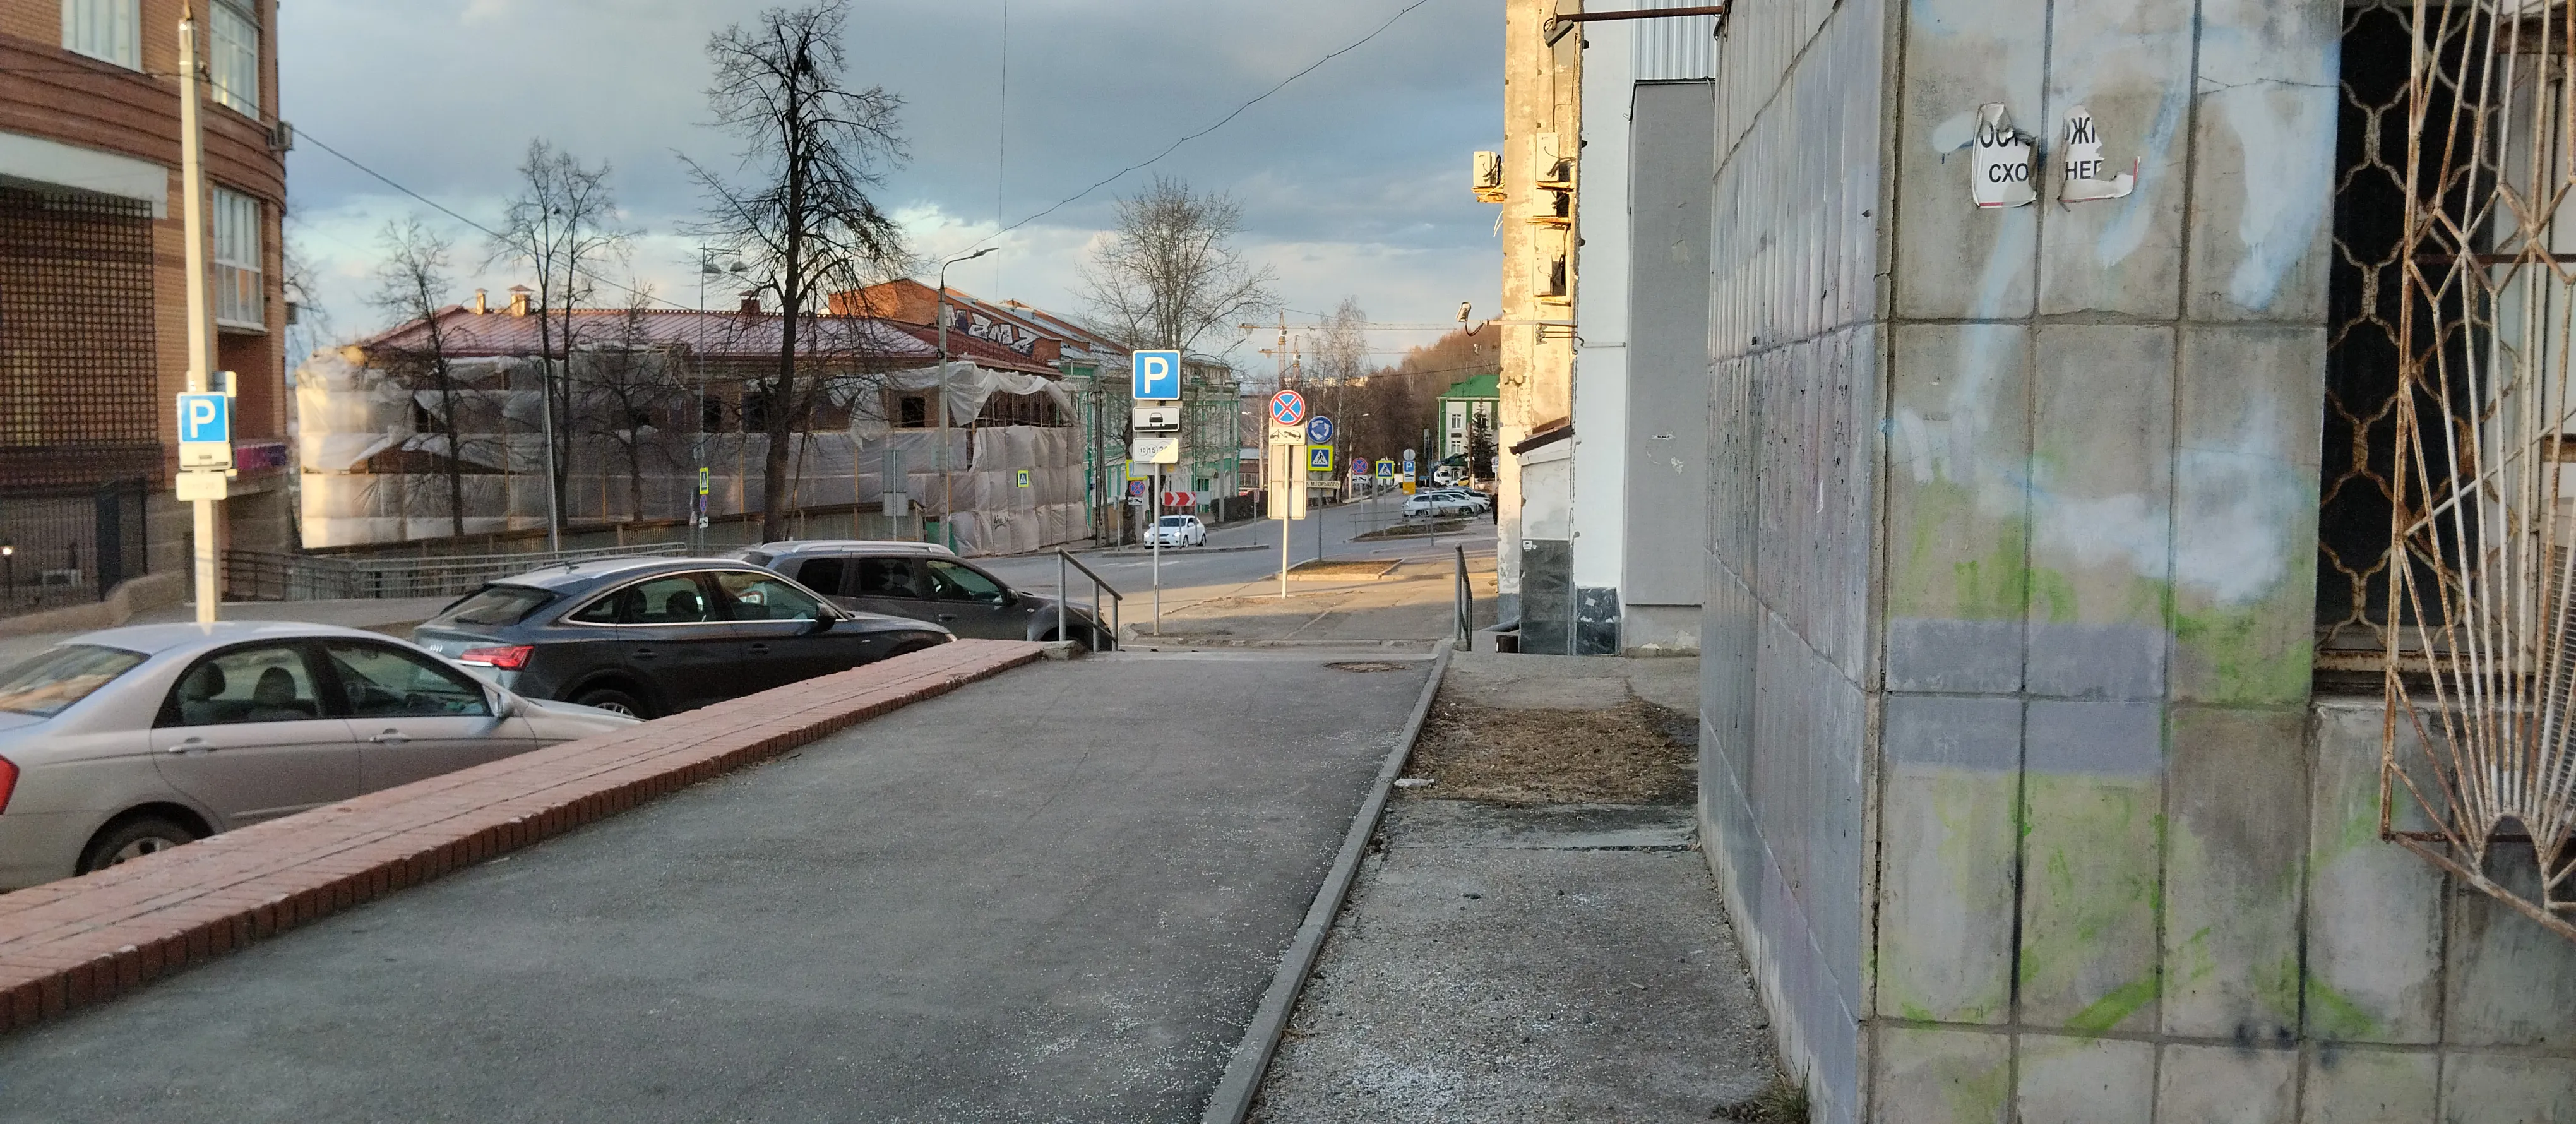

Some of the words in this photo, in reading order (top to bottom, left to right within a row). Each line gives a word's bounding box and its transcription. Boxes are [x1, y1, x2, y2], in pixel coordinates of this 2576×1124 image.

[1989, 163, 2029, 182] СХО
[1144, 357, 1168, 393] P
[190, 399, 216, 438] P
[1406, 462, 1412, 471] P
